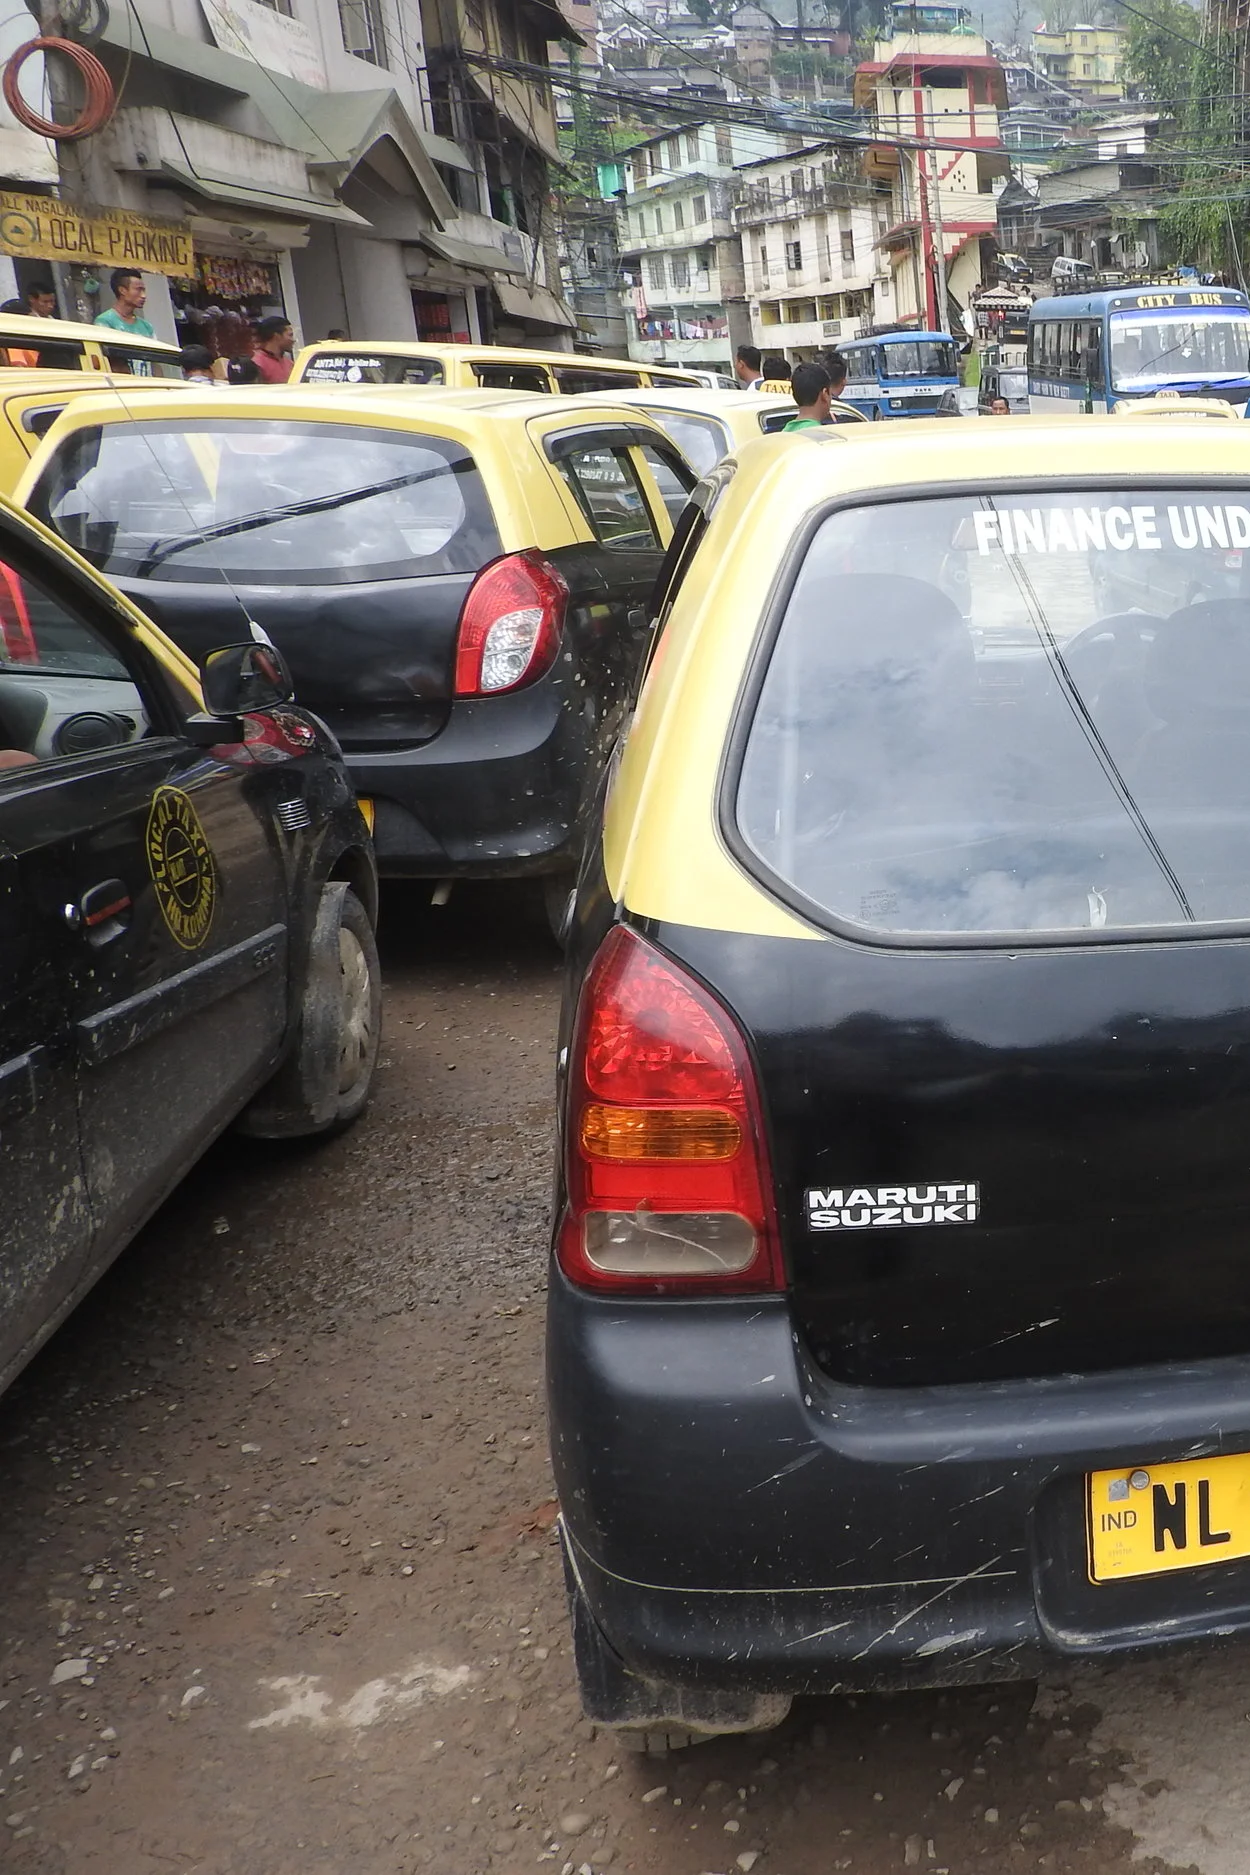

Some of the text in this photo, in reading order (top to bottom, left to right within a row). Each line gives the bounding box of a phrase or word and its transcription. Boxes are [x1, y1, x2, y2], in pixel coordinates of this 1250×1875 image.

[1136, 293, 1222, 308] CITY BUS
[1159, 391, 1176, 399] TAXI
[972, 505, 1164, 556] FINANCE
[149, 797, 174, 879] LOCAL
[808, 1184, 977, 1208] MARUTI
[809, 1203, 977, 1228] SUZUKI
[1100, 1510, 1137, 1533] IND
[1152, 1480, 1231, 1553] NL
